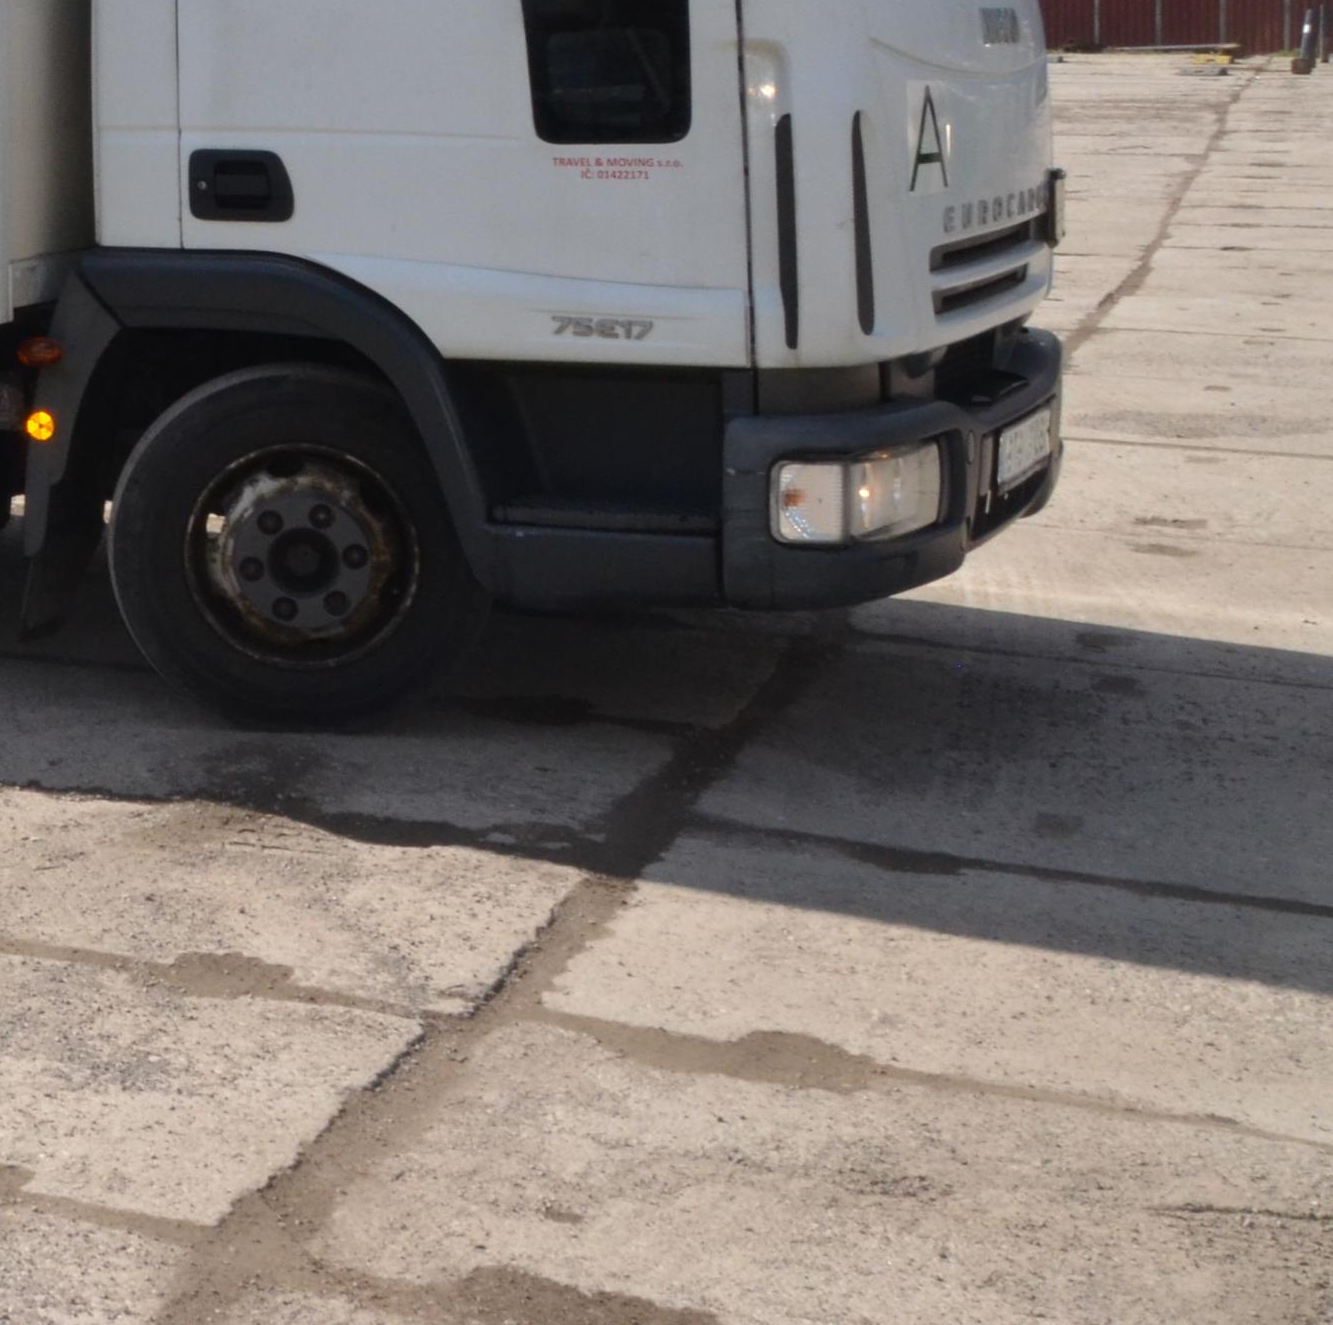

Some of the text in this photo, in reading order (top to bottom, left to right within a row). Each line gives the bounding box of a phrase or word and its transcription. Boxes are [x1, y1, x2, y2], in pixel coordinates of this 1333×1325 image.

[551, 157, 591, 167] TRAVEL
[595, 157, 603, 167] &
[606, 157, 654, 167] MOVING
